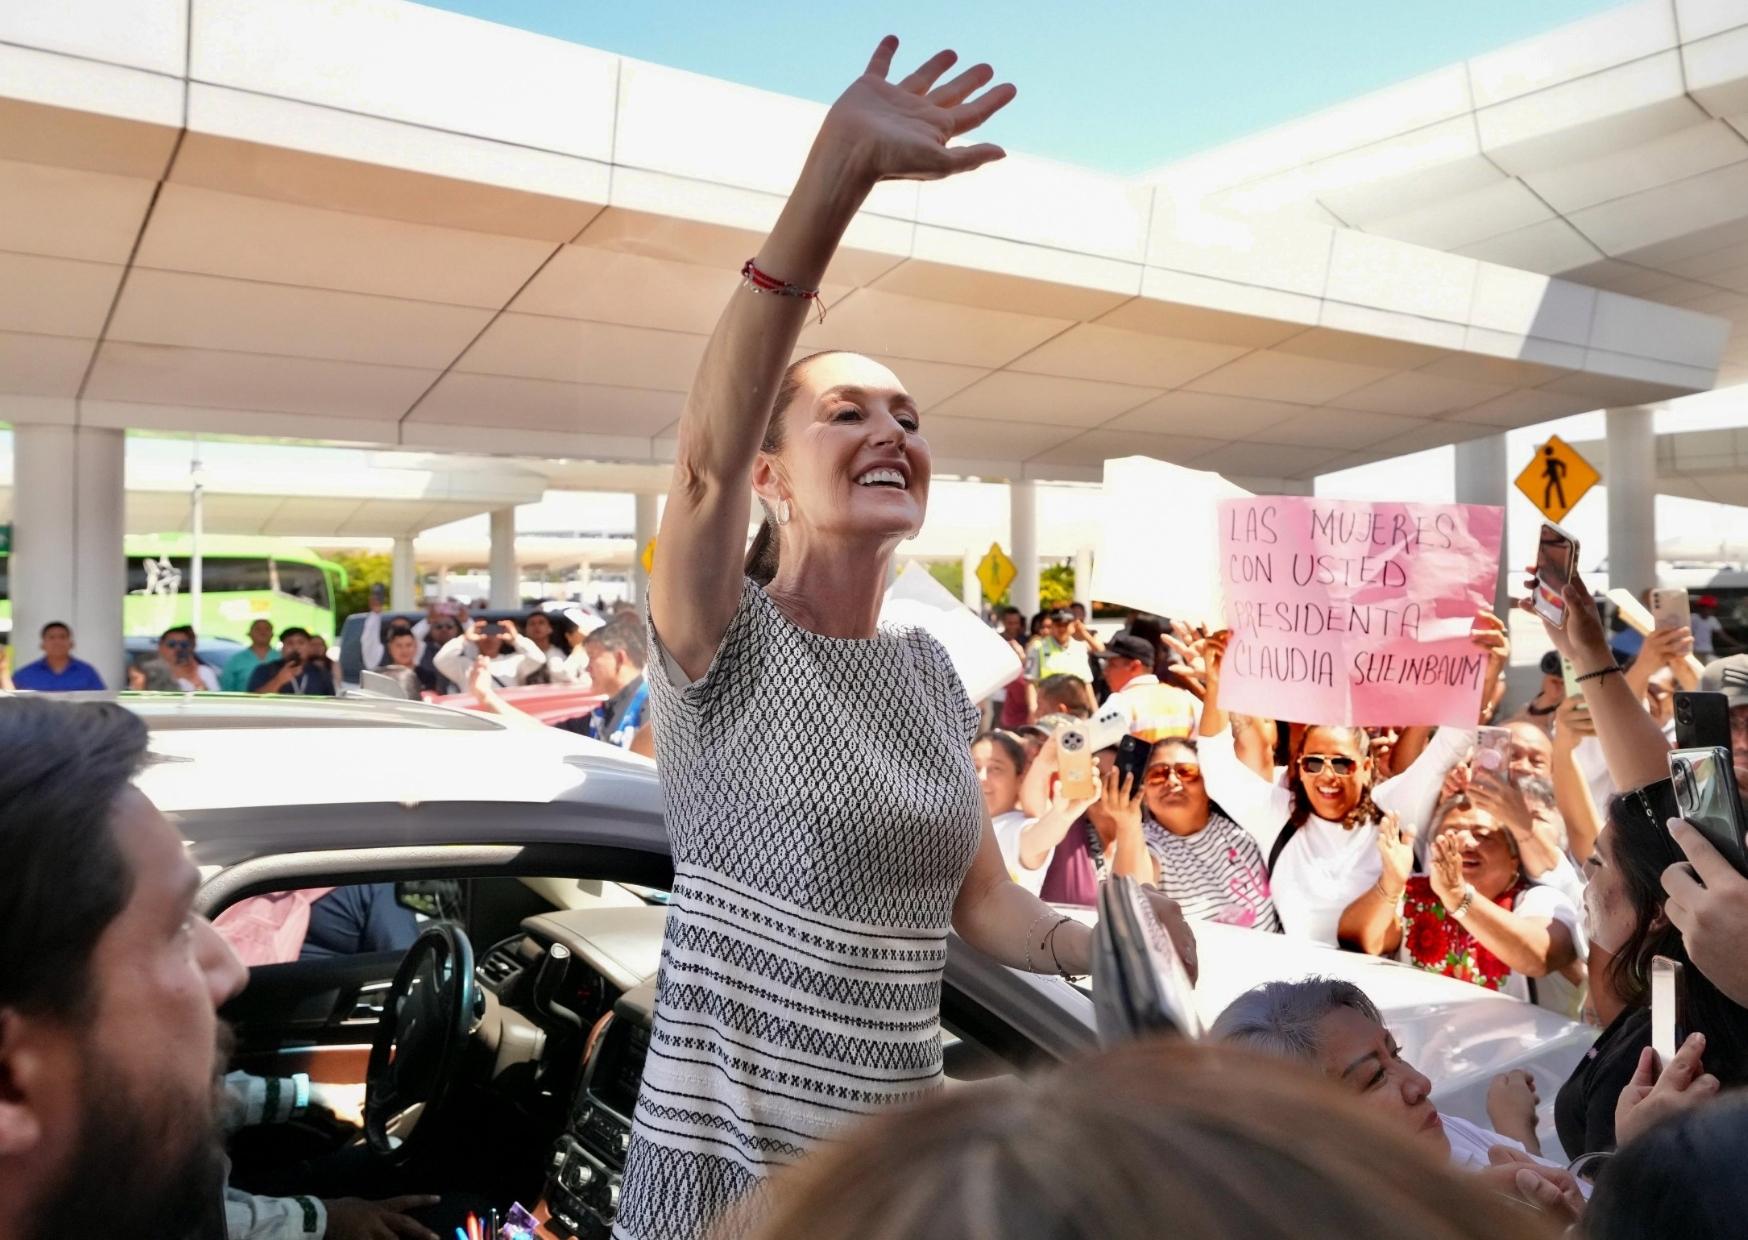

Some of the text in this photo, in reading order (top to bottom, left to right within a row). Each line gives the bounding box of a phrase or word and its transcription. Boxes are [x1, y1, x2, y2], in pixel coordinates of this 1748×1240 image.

[1230, 505, 1455, 555] LAS MUJERES
[1230, 552, 1408, 588] CON USTED
[1234, 600, 1421, 641] PRESIDENTA
[1234, 639, 1334, 688] CLAUDIA
